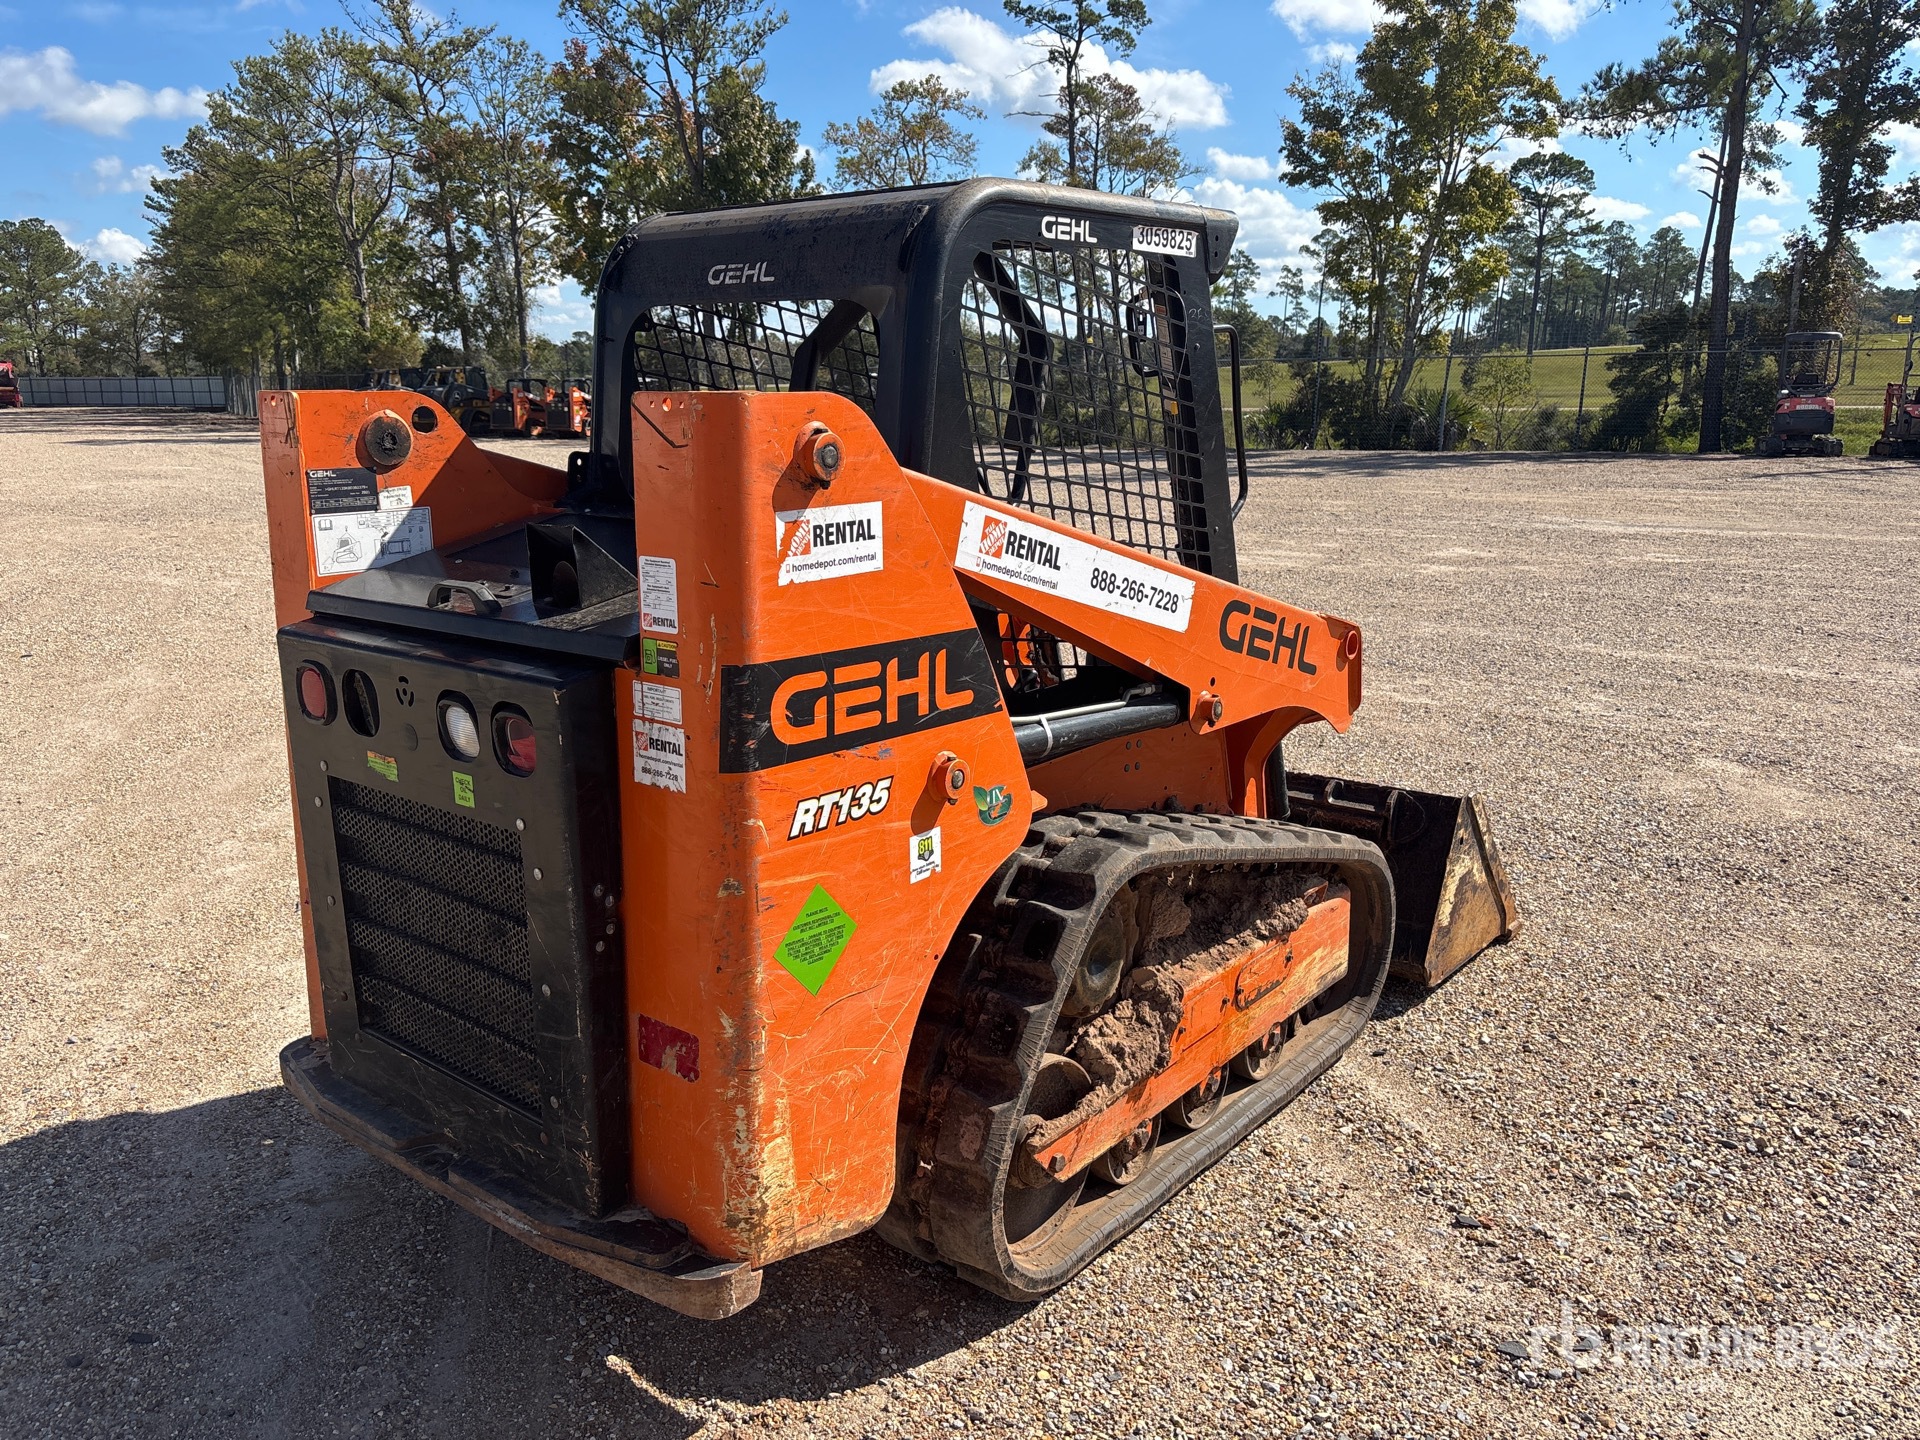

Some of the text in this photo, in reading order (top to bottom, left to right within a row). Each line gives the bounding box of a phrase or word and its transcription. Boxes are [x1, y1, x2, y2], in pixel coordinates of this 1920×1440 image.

[1041, 215, 1098, 244] GEHL
[1137, 226, 1193, 252] 3059825
[707, 261, 775, 286] GEHL
[309, 469, 337, 478] GEHL
[812, 518, 876, 548] RENTAL
[791, 551, 877, 573] homedepot.com/rental
[1004, 529, 1061, 572] RENTAL
[981, 558, 1059, 590] homedepot.com/rental
[1090, 567, 1179, 614] 888-266-7228
[652, 616, 677, 629] RENTAL
[1219, 599, 1317, 676] GEHL
[770, 648, 975, 746] GEHL
[649, 737, 684, 757] RENTAL
[787, 775, 894, 841] RT135
[918, 836, 932, 855] 811
